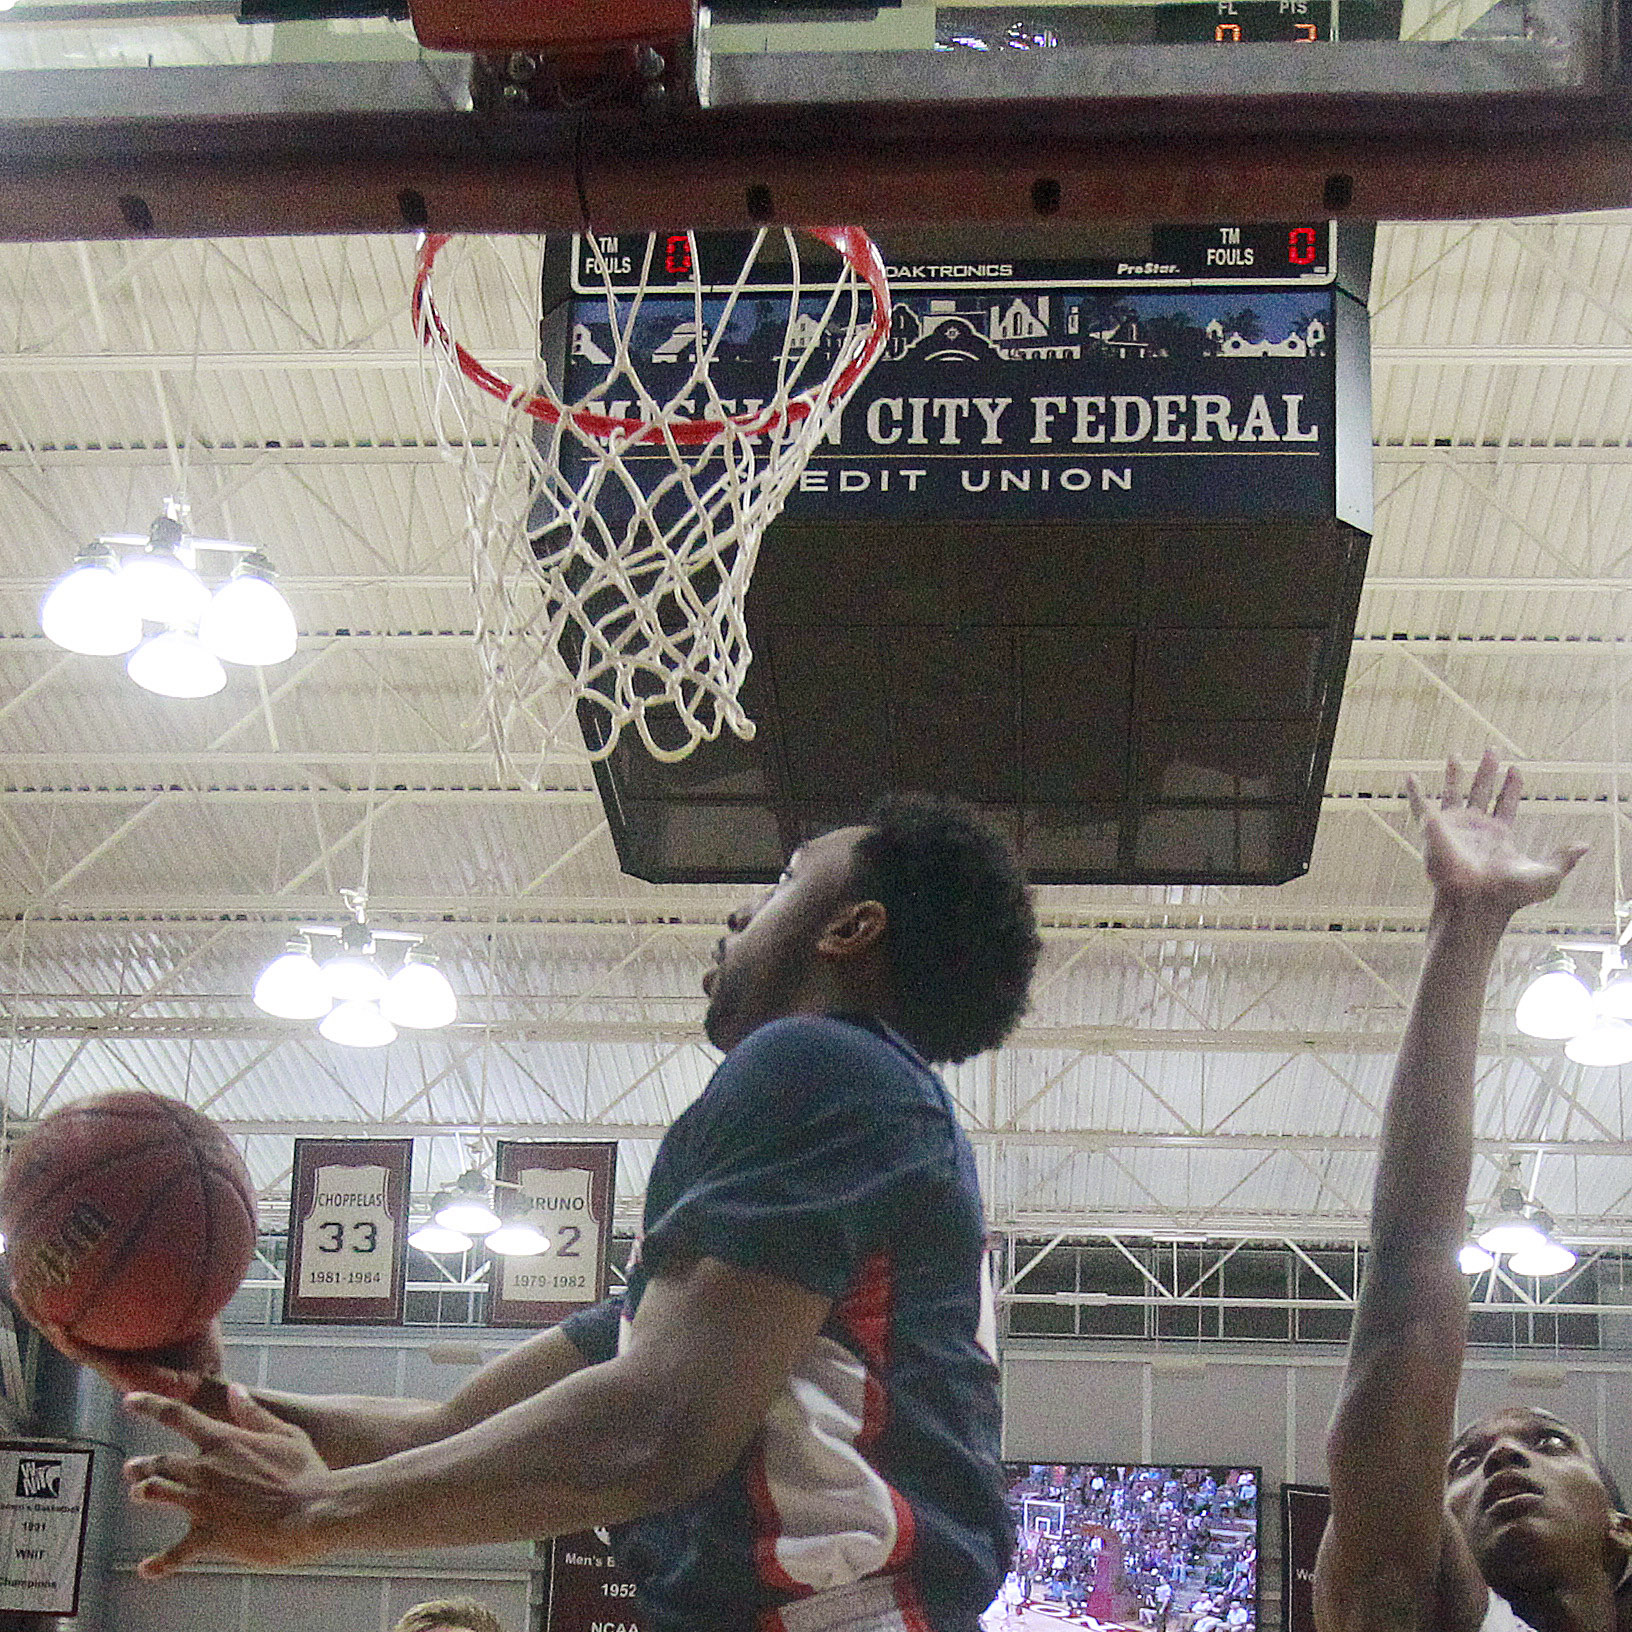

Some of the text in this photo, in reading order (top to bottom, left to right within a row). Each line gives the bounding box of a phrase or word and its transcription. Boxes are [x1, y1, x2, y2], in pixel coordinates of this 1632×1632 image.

[1219, 227, 1241, 246] TM
[1288, 227, 1316, 265] 0
[1206, 248, 1255, 266] FOULS
[884, 263, 1013, 279] DAKTRONICS
[866, 396, 1013, 446] CITY
[1029, 393, 1319, 445] FEDERAL
[788, 467, 1133, 493] EDIT UNION
[318, 1192, 383, 1208] CHOPPELAS
[318, 1222, 378, 1254] 33
[309, 1270, 382, 1286] 1981-1984
[513, 1274, 587, 1289] 1979-1982
[565, 1552, 603, 1568] Men's
[600, 1583, 638, 1598] 1952
